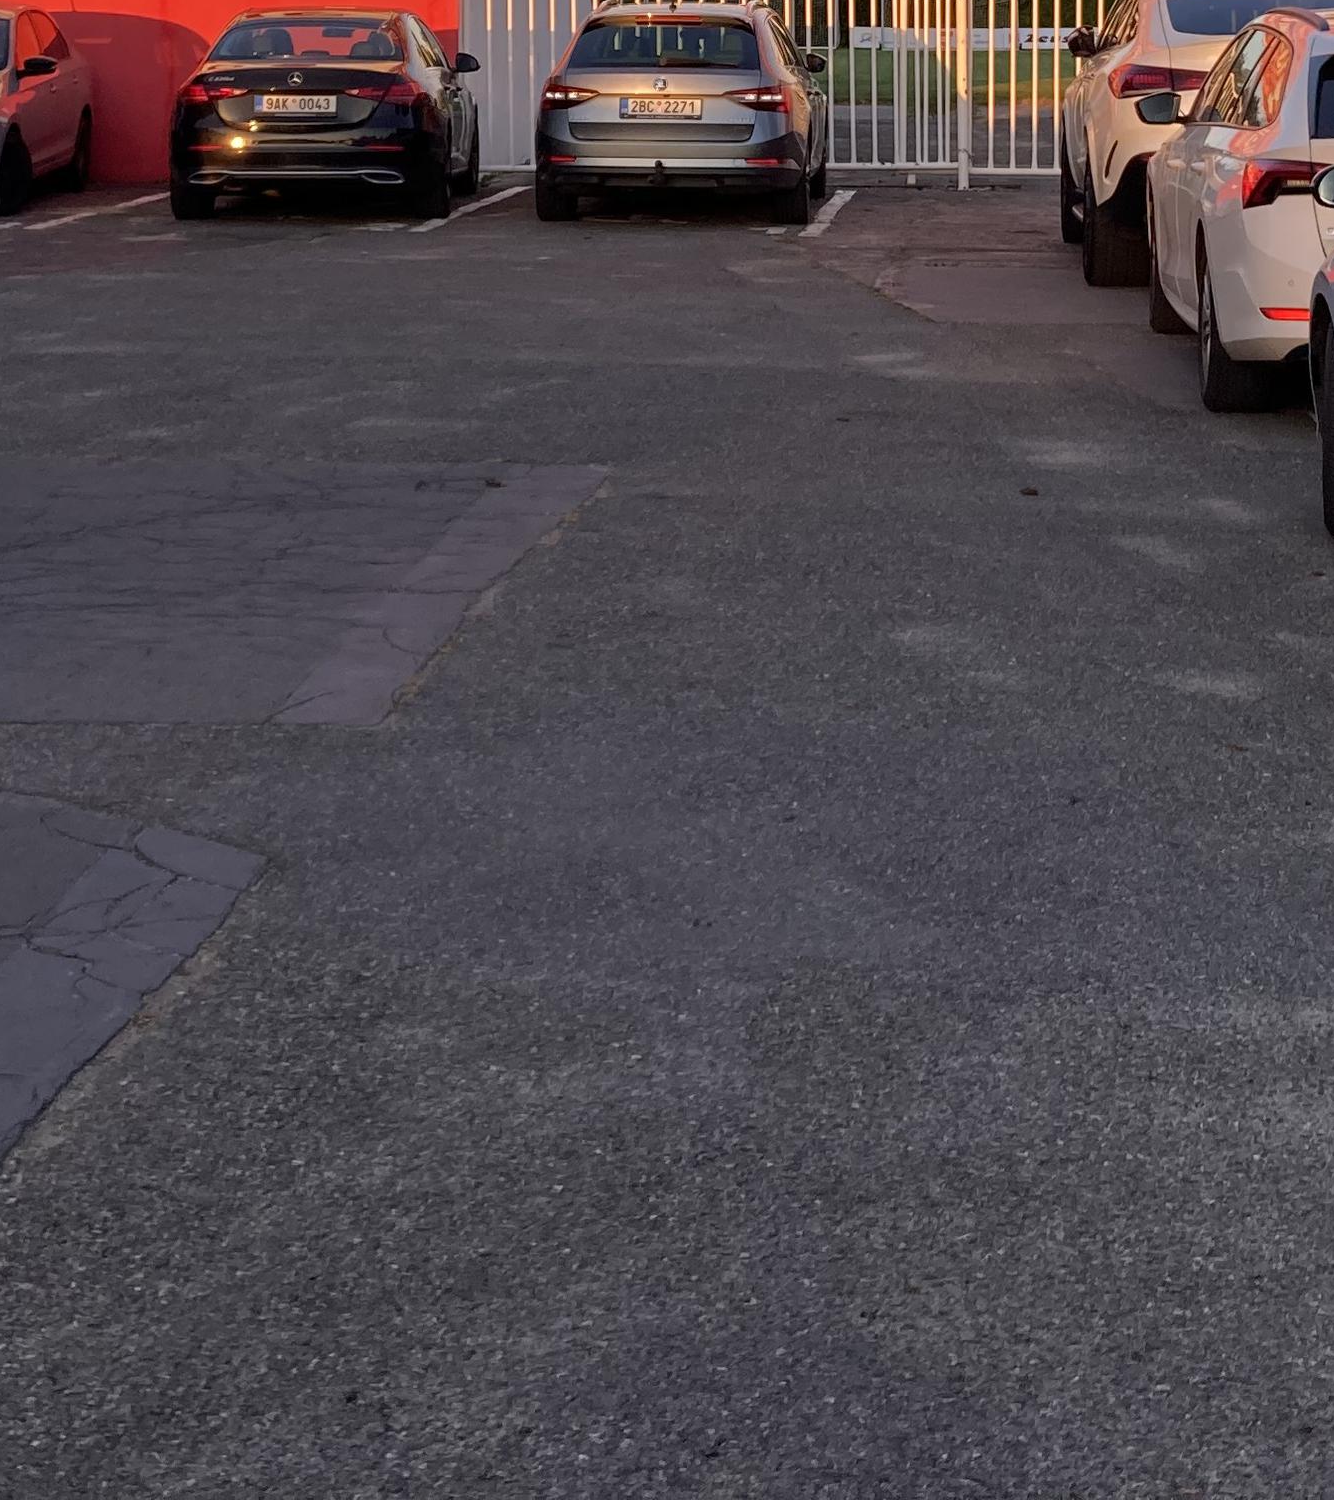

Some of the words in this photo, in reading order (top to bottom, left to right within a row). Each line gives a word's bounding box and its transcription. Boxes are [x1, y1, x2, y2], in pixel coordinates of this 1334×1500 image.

[265, 97, 288, 111] 9AK
[299, 97, 331, 110] 0043
[630, 100, 655, 113] 2BC
[663, 101, 695, 114] 2271
